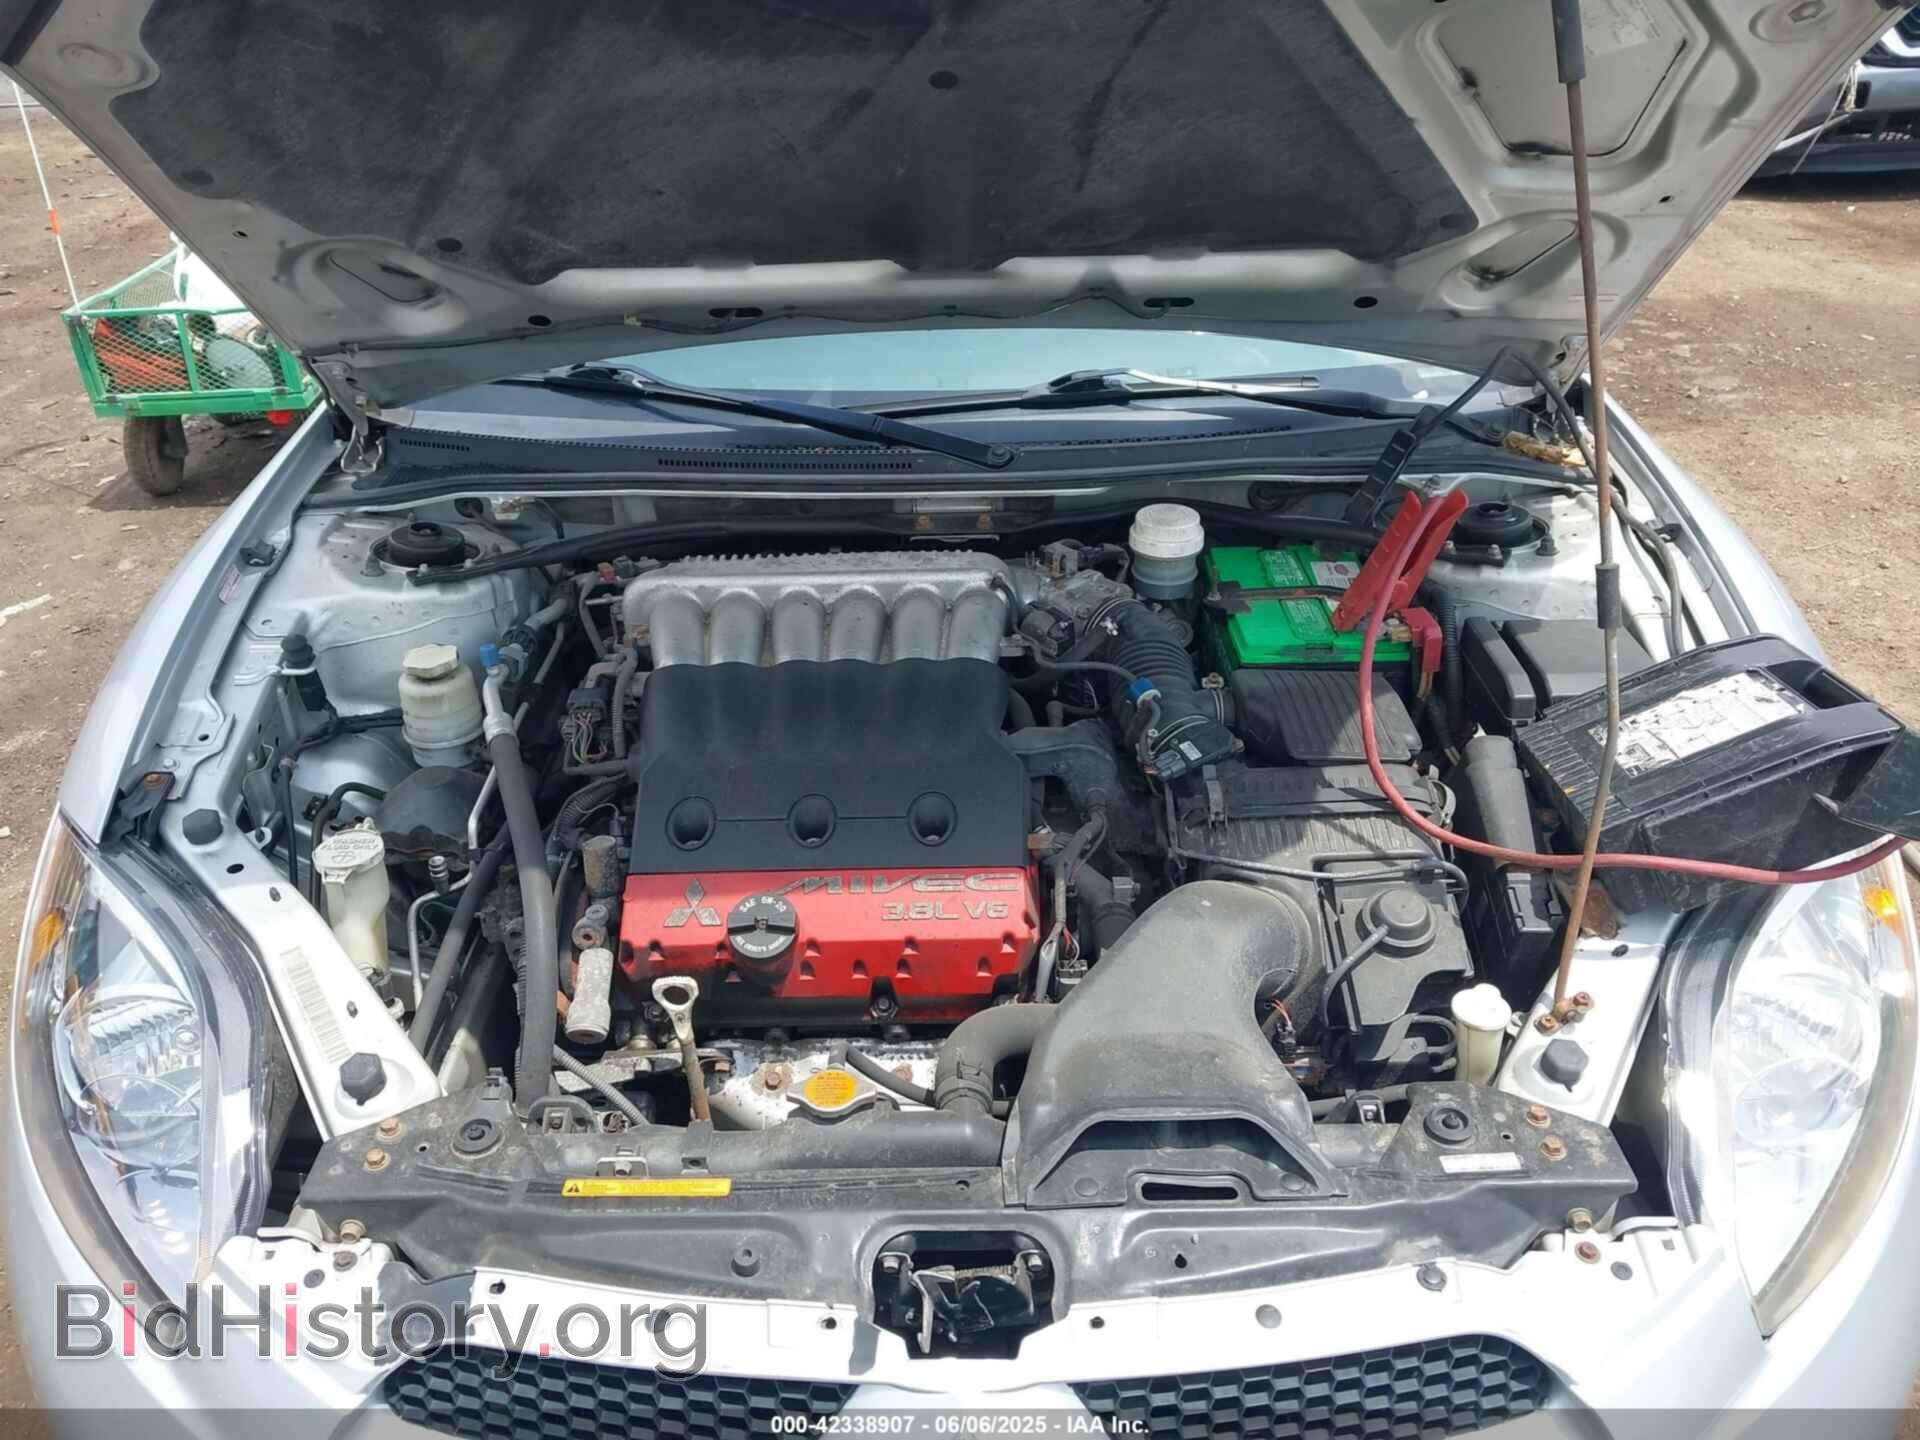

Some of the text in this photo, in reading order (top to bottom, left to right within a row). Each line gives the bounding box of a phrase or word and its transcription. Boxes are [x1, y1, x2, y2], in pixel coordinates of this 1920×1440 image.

[776, 872, 1019, 896] MIVEC
[881, 900, 1009, 921] 3.8L V6
